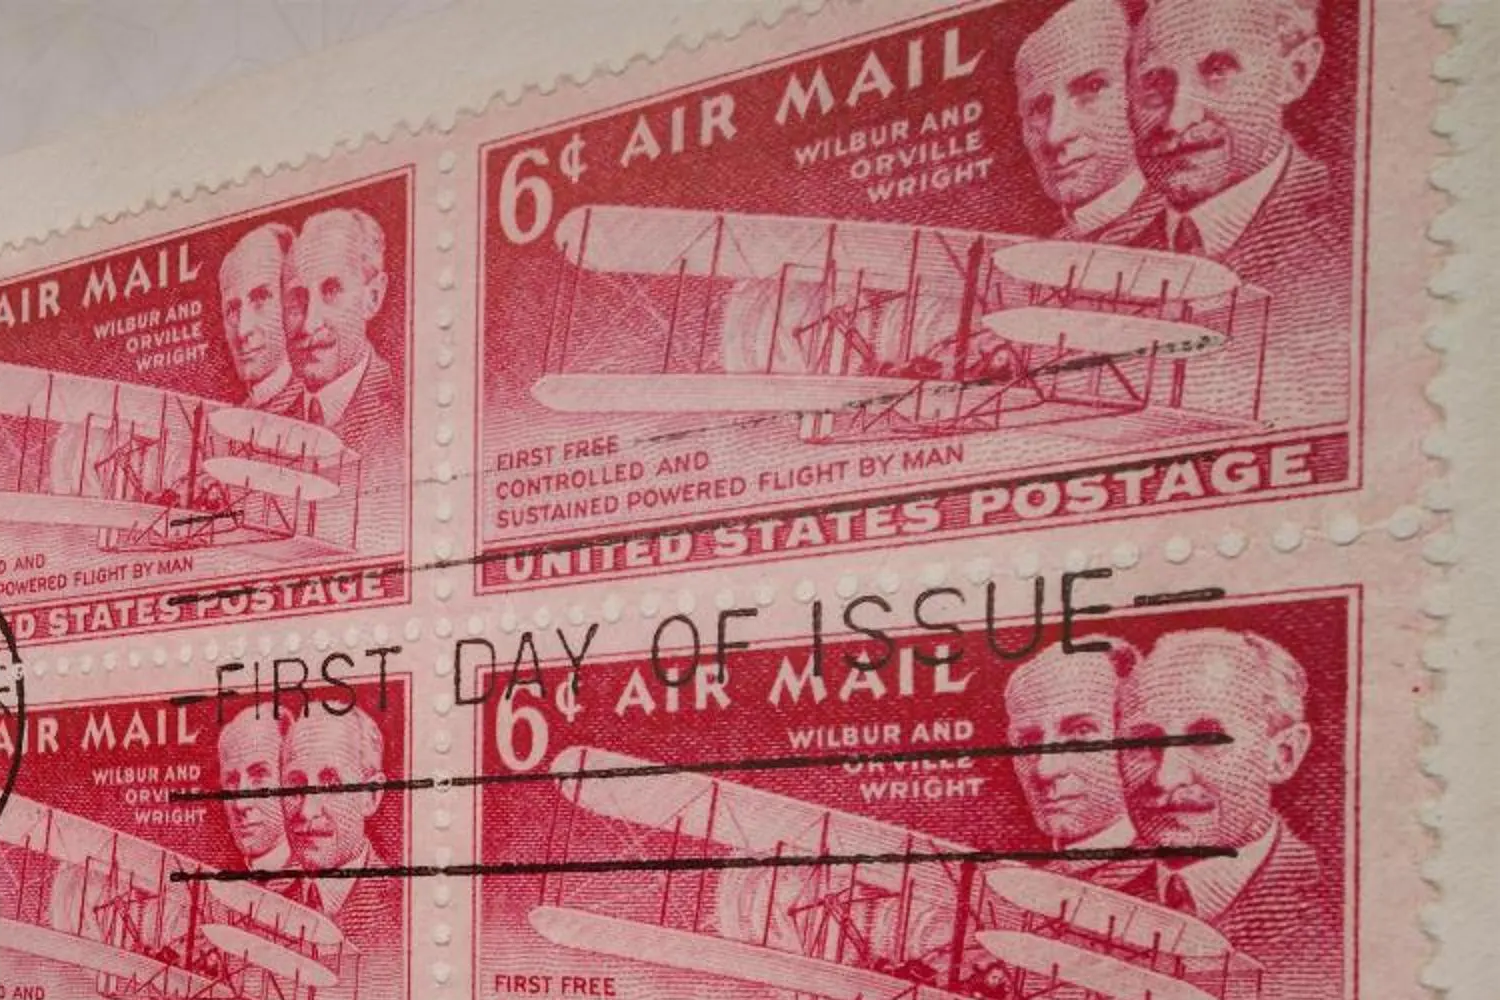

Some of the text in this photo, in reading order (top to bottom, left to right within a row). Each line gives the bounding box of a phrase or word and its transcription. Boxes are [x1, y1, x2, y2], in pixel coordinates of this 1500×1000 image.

[621, 92, 737, 167] AIR
[775, 28, 986, 125] MAIL
[795, 101, 983, 165] WILBUR AND
[850, 131, 982, 180] ORVILLE
[867, 158, 993, 204] WRIGHT
[83, 240, 202, 309] MAIL
[93, 300, 203, 340] WILBUR AND
[126, 323, 202, 351] ORVILLE
[136, 343, 209, 372] WRIGHT
[496, 434, 620, 471] FIRST FREE
[496, 451, 710, 501] CONTROLLED AND
[497, 443, 964, 529] SUSTAINED POWERED FLIGHT BY MAN
[505, 443, 1315, 581] UNITED STATES POSTAGE
[14, 554, 45, 570] AND
[74, 567, 126, 588] FLIGHT
[133, 562, 156, 579] BY
[158, 556, 193, 576] MAN
[50, 593, 181, 637] STATES
[197, 568, 385, 618] POSTAGE
[215, 569, 1116, 723] FIRST DAY OF ISSUE
[616, 659, 732, 716] AIR
[769, 644, 979, 707] MAIL
[81, 706, 199, 751] MAIL
[788, 720, 974, 750] WILBUR AND
[92, 765, 200, 786] WILBUR AND
[860, 777, 985, 803] WRIGHT
[135, 808, 207, 826] WRIGHT
[494, 974, 617, 998] FIRST FREE
